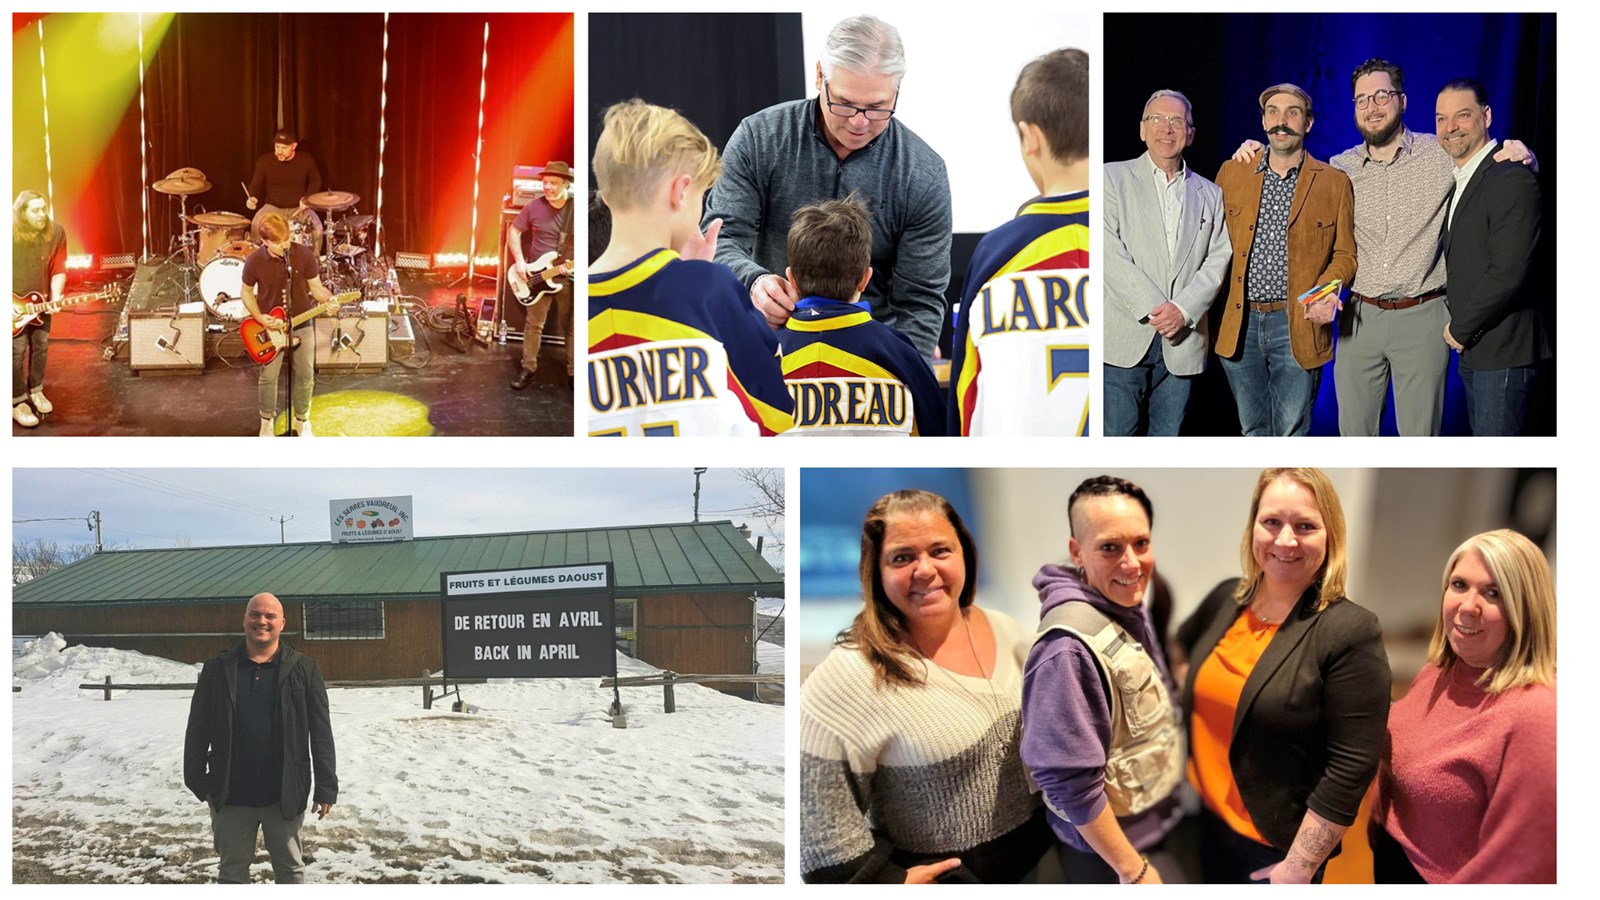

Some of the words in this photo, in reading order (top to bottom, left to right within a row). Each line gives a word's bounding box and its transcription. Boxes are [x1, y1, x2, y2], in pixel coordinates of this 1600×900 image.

[334, 515, 344, 527] LES
[343, 501, 365, 516] SERRES
[366, 500, 399, 513] VAUDREUIL
[399, 510, 409, 523] INC.
[449, 579, 485, 590] FRUITS
[487, 578, 500, 587] ET
[504, 575, 555, 586] LÉGUMES
[558, 572, 604, 582] DAOUST
[454, 615, 470, 630] DE
[474, 614, 525, 630] RETOUR
[532, 613, 551, 628] EN
[559, 611, 602, 627] AVRIL
[474, 645, 510, 661] BACK
[517, 645, 532, 660] IN
[539, 644, 580, 660] APRIL
